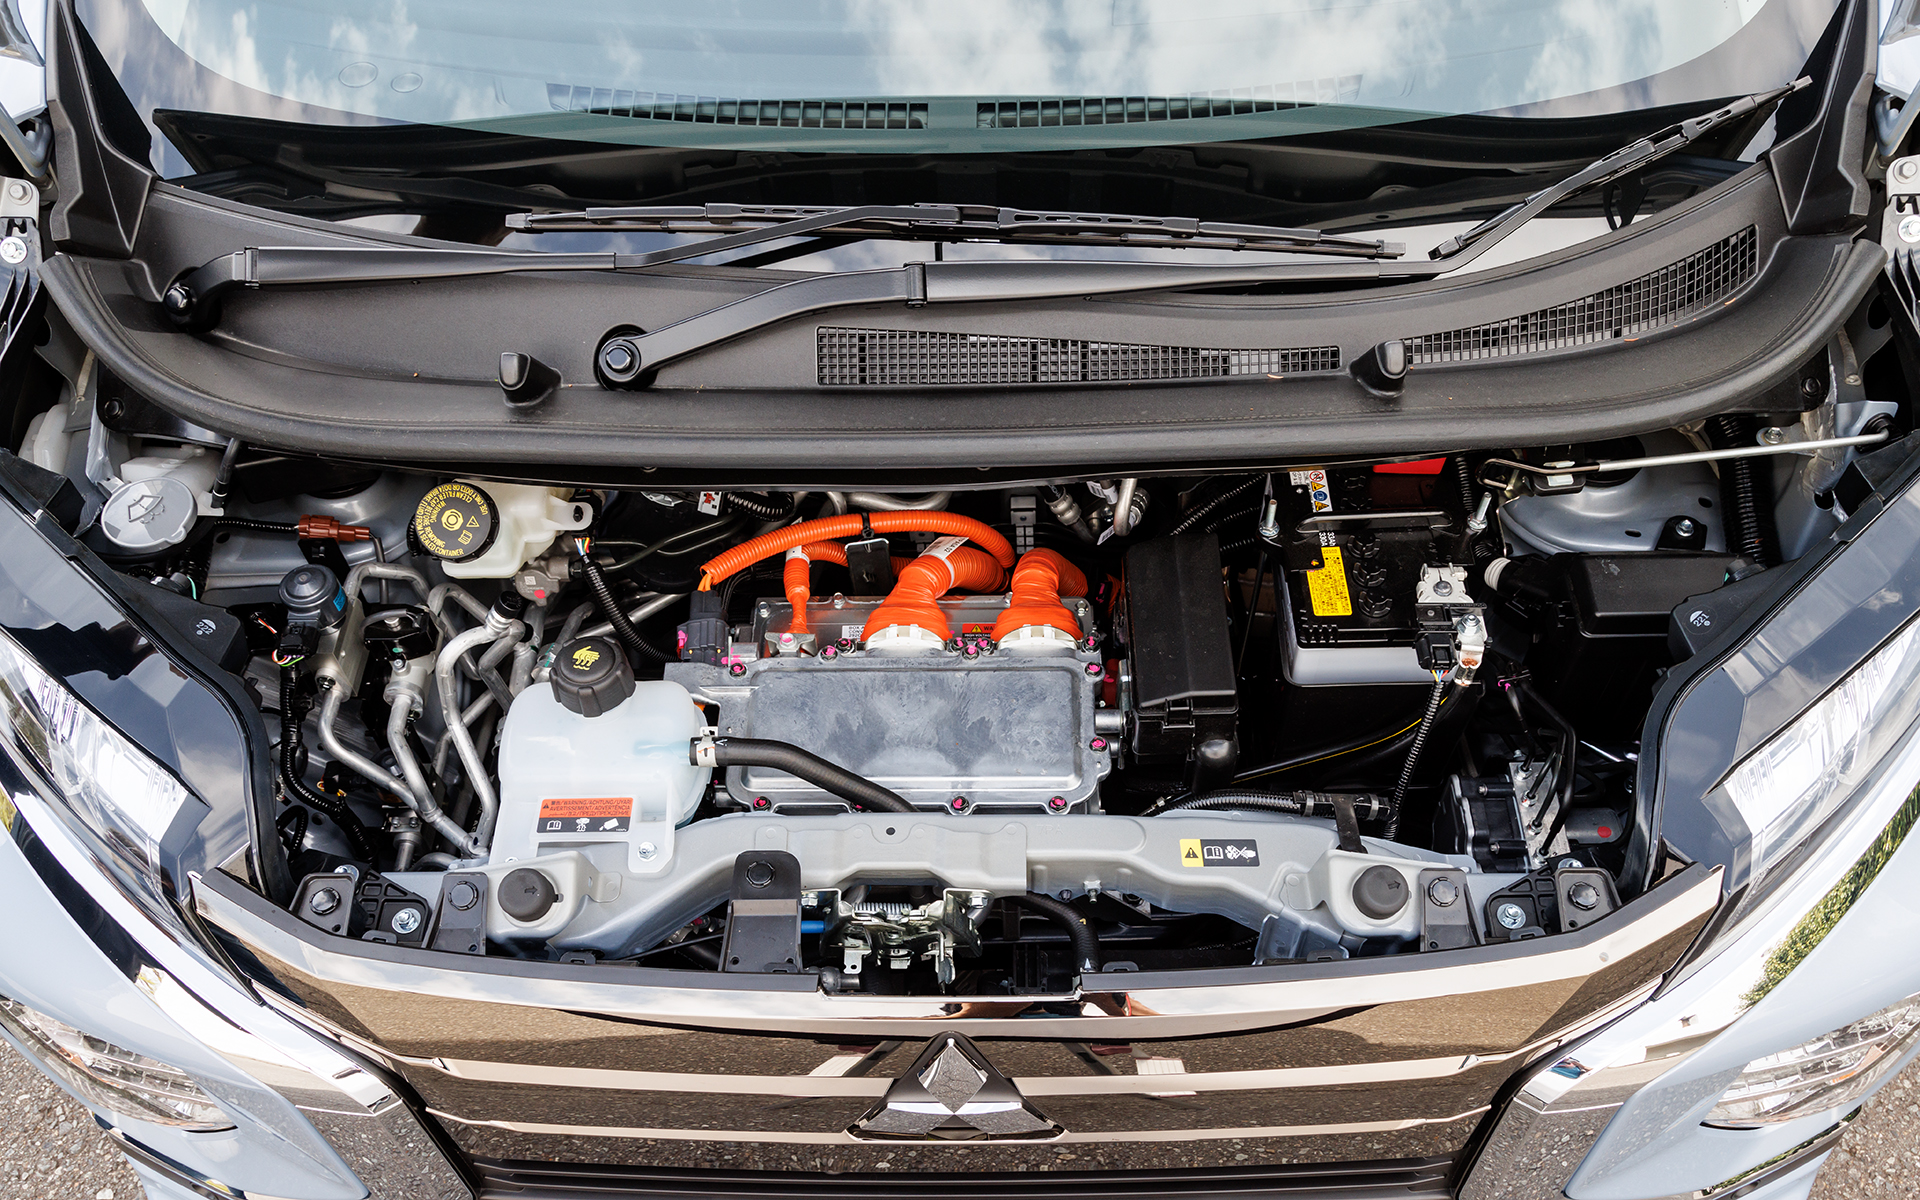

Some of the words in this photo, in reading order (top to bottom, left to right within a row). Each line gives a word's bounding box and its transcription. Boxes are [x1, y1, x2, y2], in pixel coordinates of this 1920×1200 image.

[424, 488, 439, 502] BRAKE
[428, 496, 439, 507] CAP
[438, 491, 455, 500] FILLER
[455, 491, 472, 503] CLEAN
[471, 492, 483, 505] ONLY
[417, 500, 428, 515] FLUID
[430, 499, 446, 523] WARNING
[479, 504, 488, 515] USE
[423, 505, 433, 525] BEFORE
[420, 533, 436, 550] SEALED
[425, 526, 445, 547] REMOVING
[435, 547, 463, 556] CONTAINER
[1693, 613, 1710, 627] 221
[196, 622, 214, 635] 222
